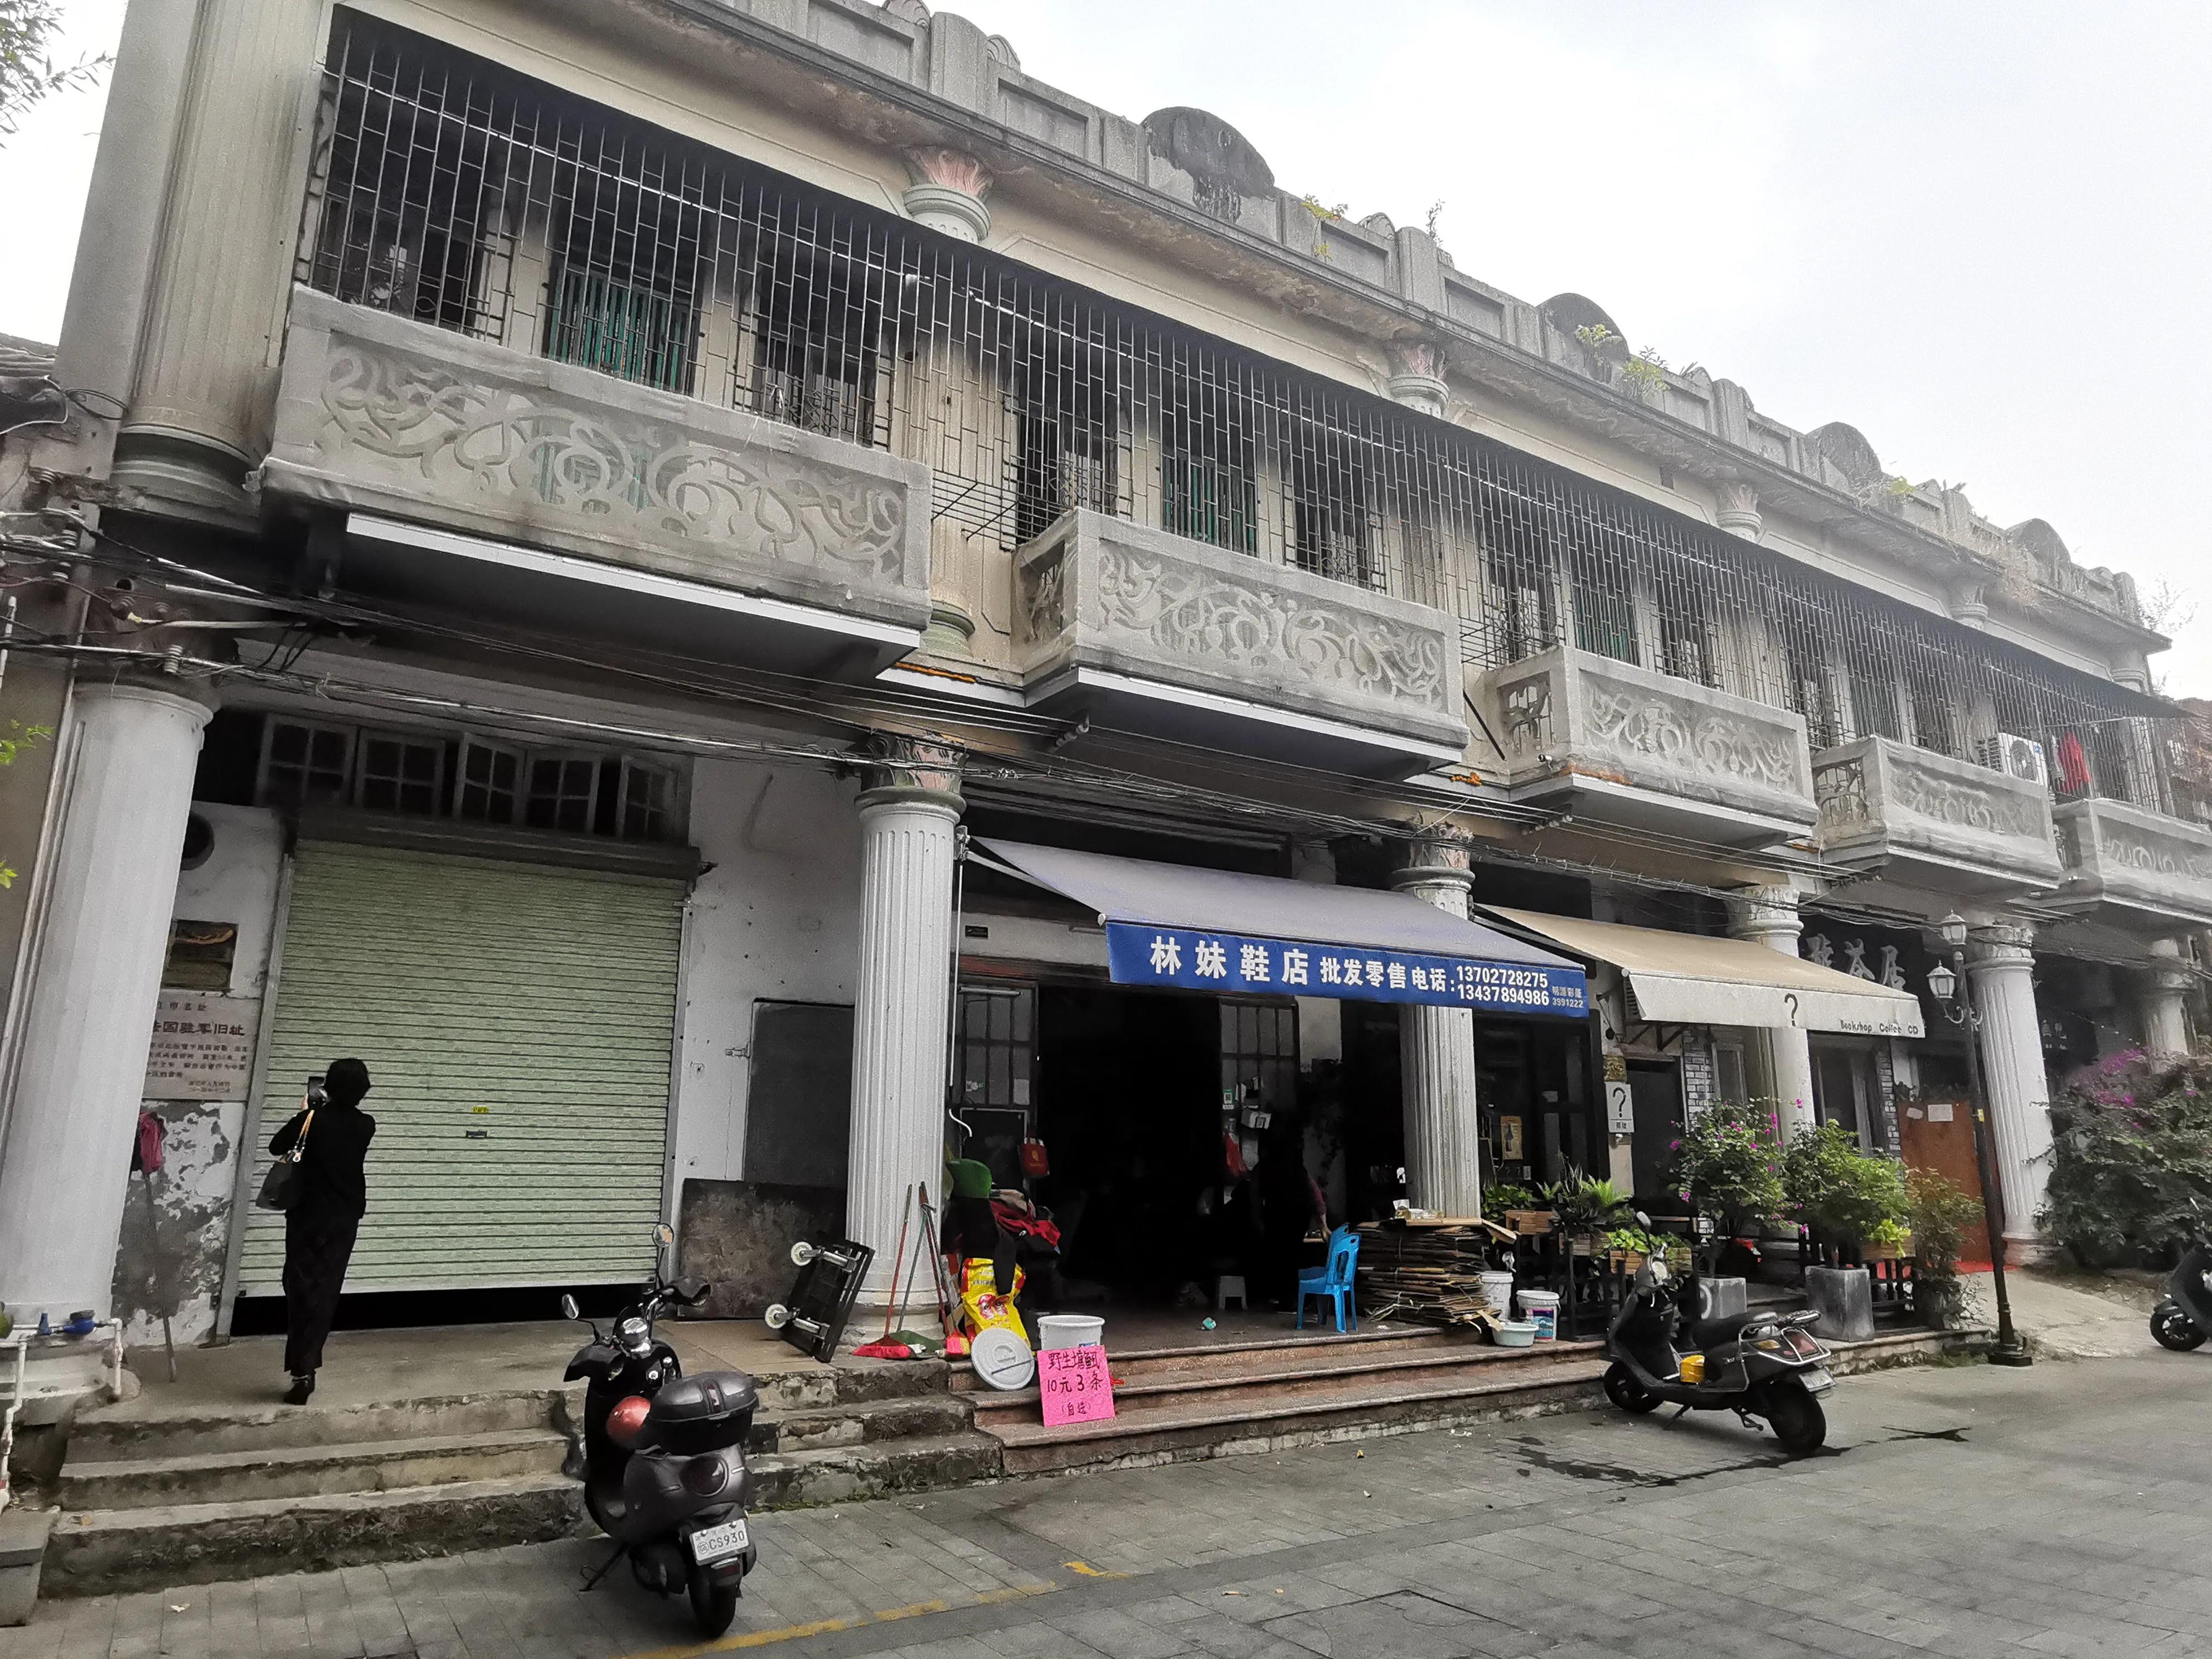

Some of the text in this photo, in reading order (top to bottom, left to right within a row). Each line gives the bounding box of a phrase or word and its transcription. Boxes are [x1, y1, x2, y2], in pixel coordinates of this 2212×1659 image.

[1150, 936, 1309, 985] 林妹鞋店
[1320, 957, 1406, 989] 批发零售
[1457, 966, 1548, 988] 13702728275
[1458, 984, 1549, 1006] 13437894986
[1552, 997, 1584, 1008] 3991222
[1840, 1020, 1919, 1035] Bookshop Coffee CD
